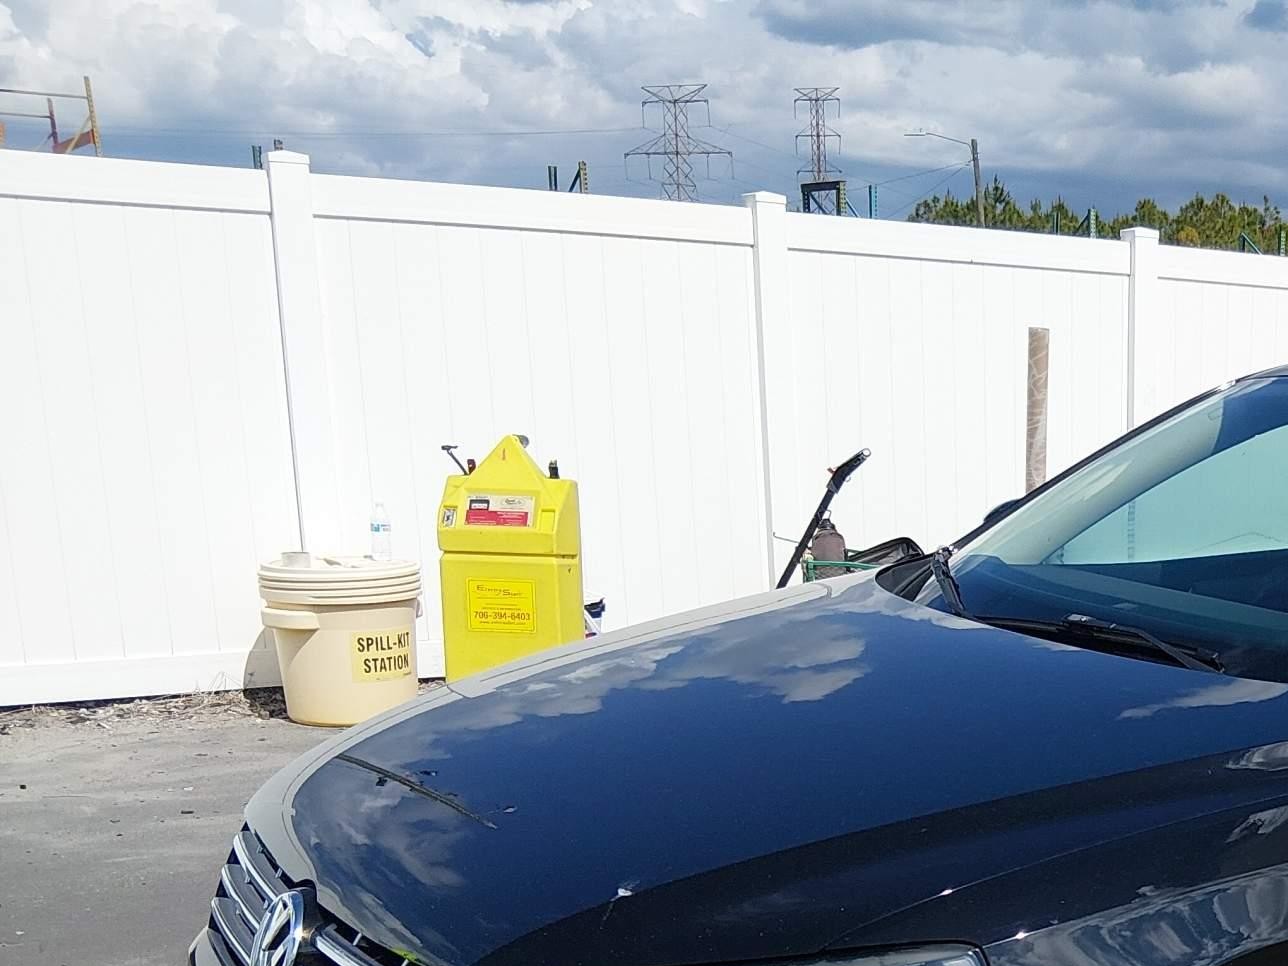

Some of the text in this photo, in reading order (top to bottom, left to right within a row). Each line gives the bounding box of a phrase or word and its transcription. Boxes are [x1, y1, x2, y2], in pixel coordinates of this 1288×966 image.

[474, 611, 531, 621] 706-394-6403
[357, 632, 410, 652] SPILL-KIT
[363, 653, 409, 673] STATION
